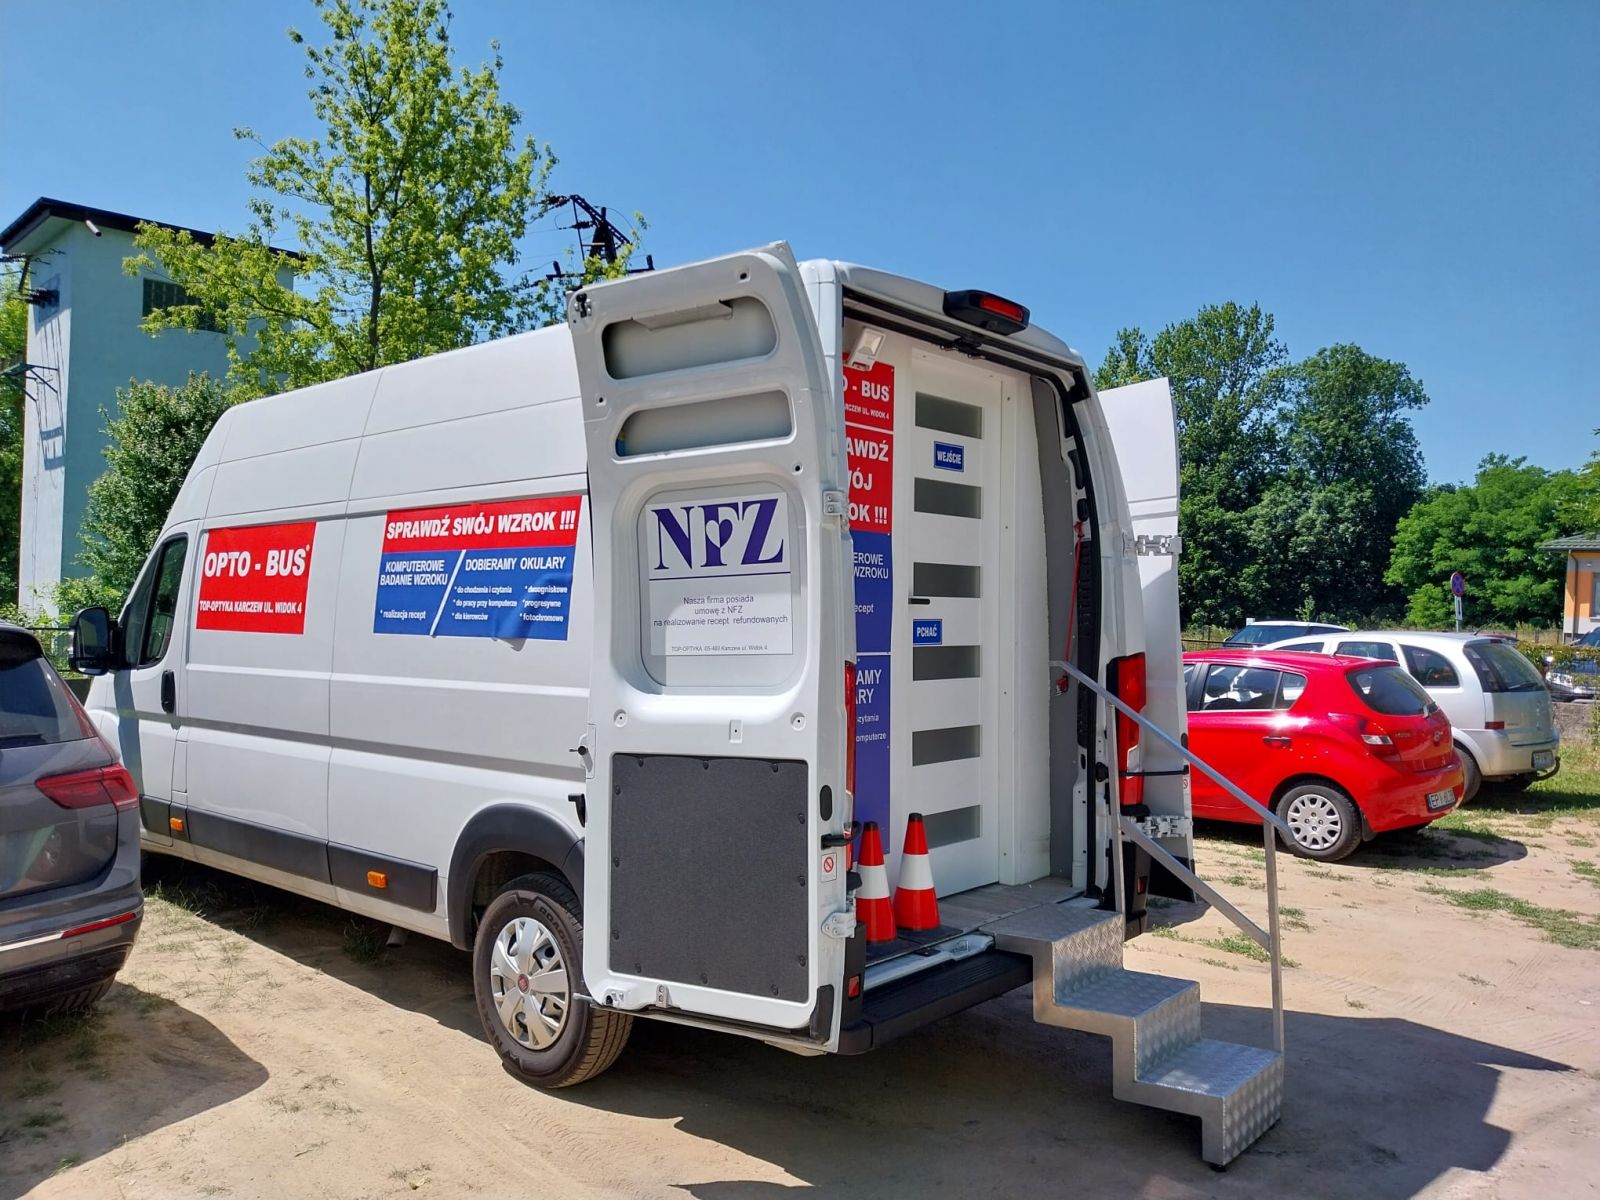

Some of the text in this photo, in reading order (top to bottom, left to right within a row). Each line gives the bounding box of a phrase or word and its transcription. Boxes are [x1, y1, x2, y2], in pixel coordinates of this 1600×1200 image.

[861, 380, 890, 402] BUS
[845, 436, 889, 462] AWDŹ
[936, 450, 962, 465] WEJŚCIE
[848, 502, 888, 525] OK !!!
[386, 510, 577, 540] SPRAWDŹ SWÓJ WZROK !!!
[650, 498, 784, 570] NFZ
[204, 550, 251, 577] OPTO
[265, 548, 307, 577] BUS
[465, 556, 566, 571] DOBIERAMY OKULARY
[853, 551, 884, 566] EROWE
[385, 559, 445, 573] KOMPUTEROWE
[380, 573, 448, 586] BADANIE WZROKU
[456, 586, 464, 594] do
[455, 599, 518, 609] do pracy przy komputerze
[683, 594, 754, 605] Nasza firma posiada
[199, 600, 303, 614] TOP-OPTYKA KARCZEW UL. WIDOK 4
[694, 607, 720, 616] umowę
[727, 605, 744, 614] NFZ
[382, 610, 426, 621] realizacja recept
[454, 612, 463, 620] dla
[653, 614, 788, 627] na realizowanie recept refundowanych
[916, 624, 938, 637] PCHAĆ
[855, 669, 882, 685] AMY
[855, 688, 874, 705] RY
